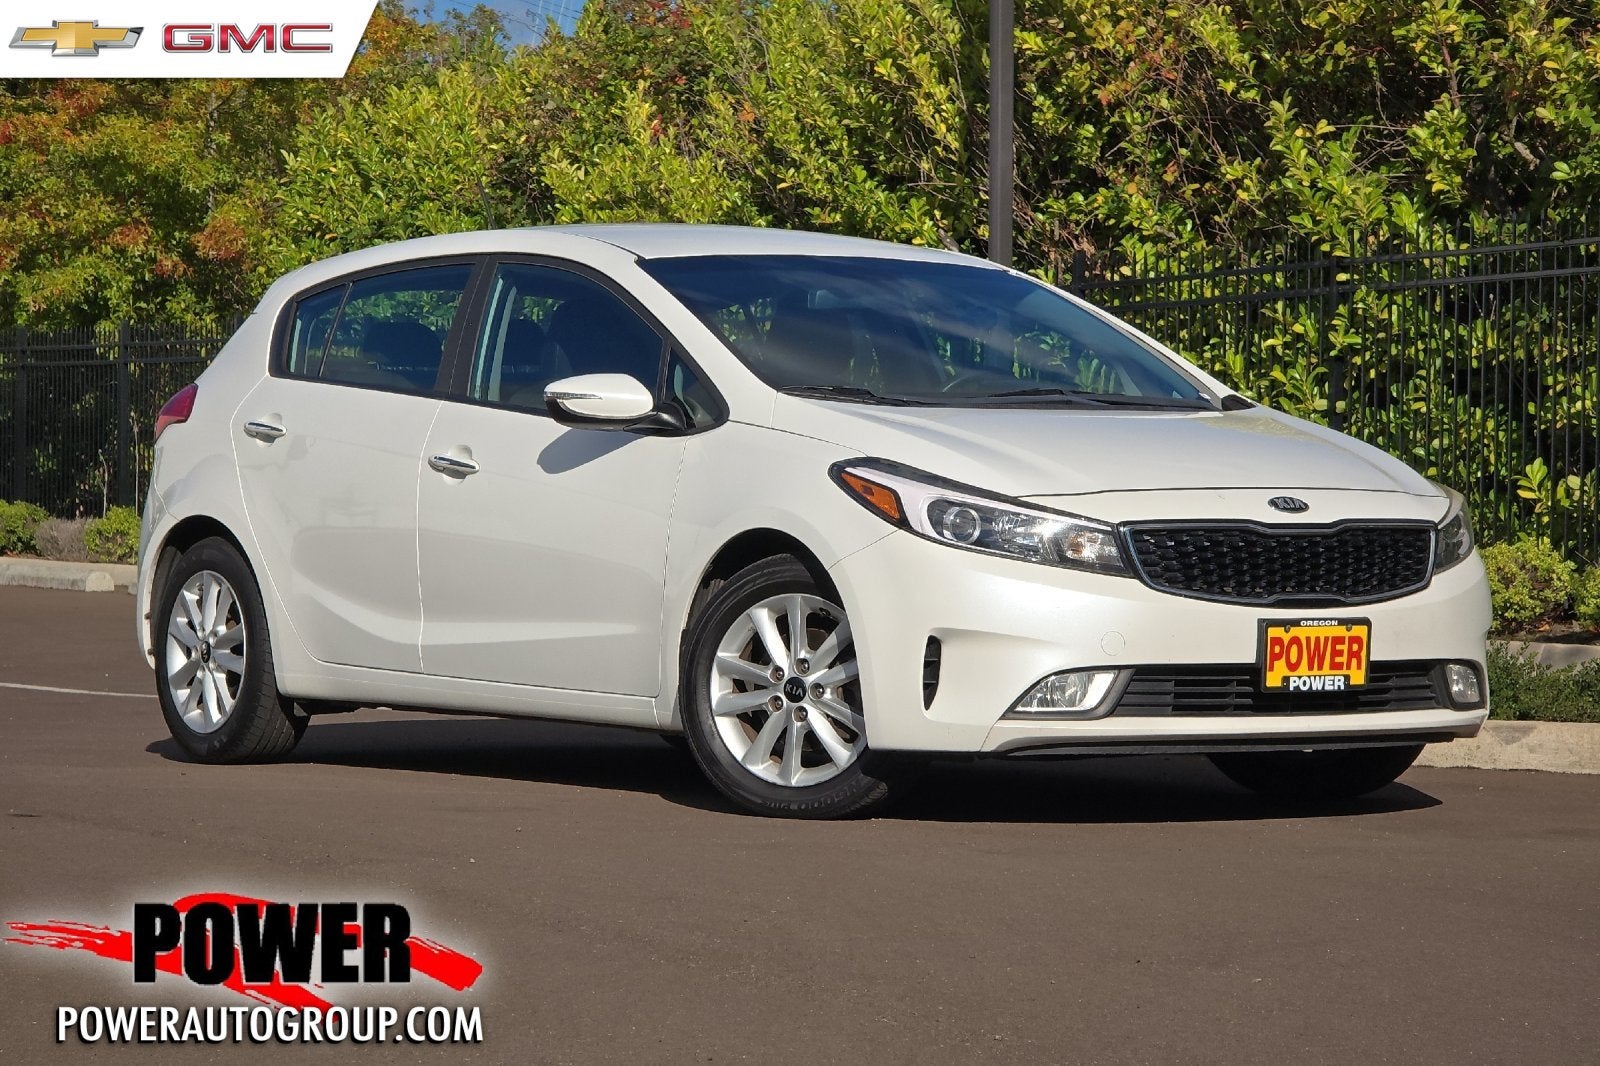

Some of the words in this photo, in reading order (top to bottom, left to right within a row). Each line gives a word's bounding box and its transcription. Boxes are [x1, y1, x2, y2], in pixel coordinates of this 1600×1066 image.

[1272, 497, 1307, 510] KIA
[1268, 635, 1364, 672] POWER
[785, 683, 804, 698] KIA
[1289, 675, 1345, 691] POWER
